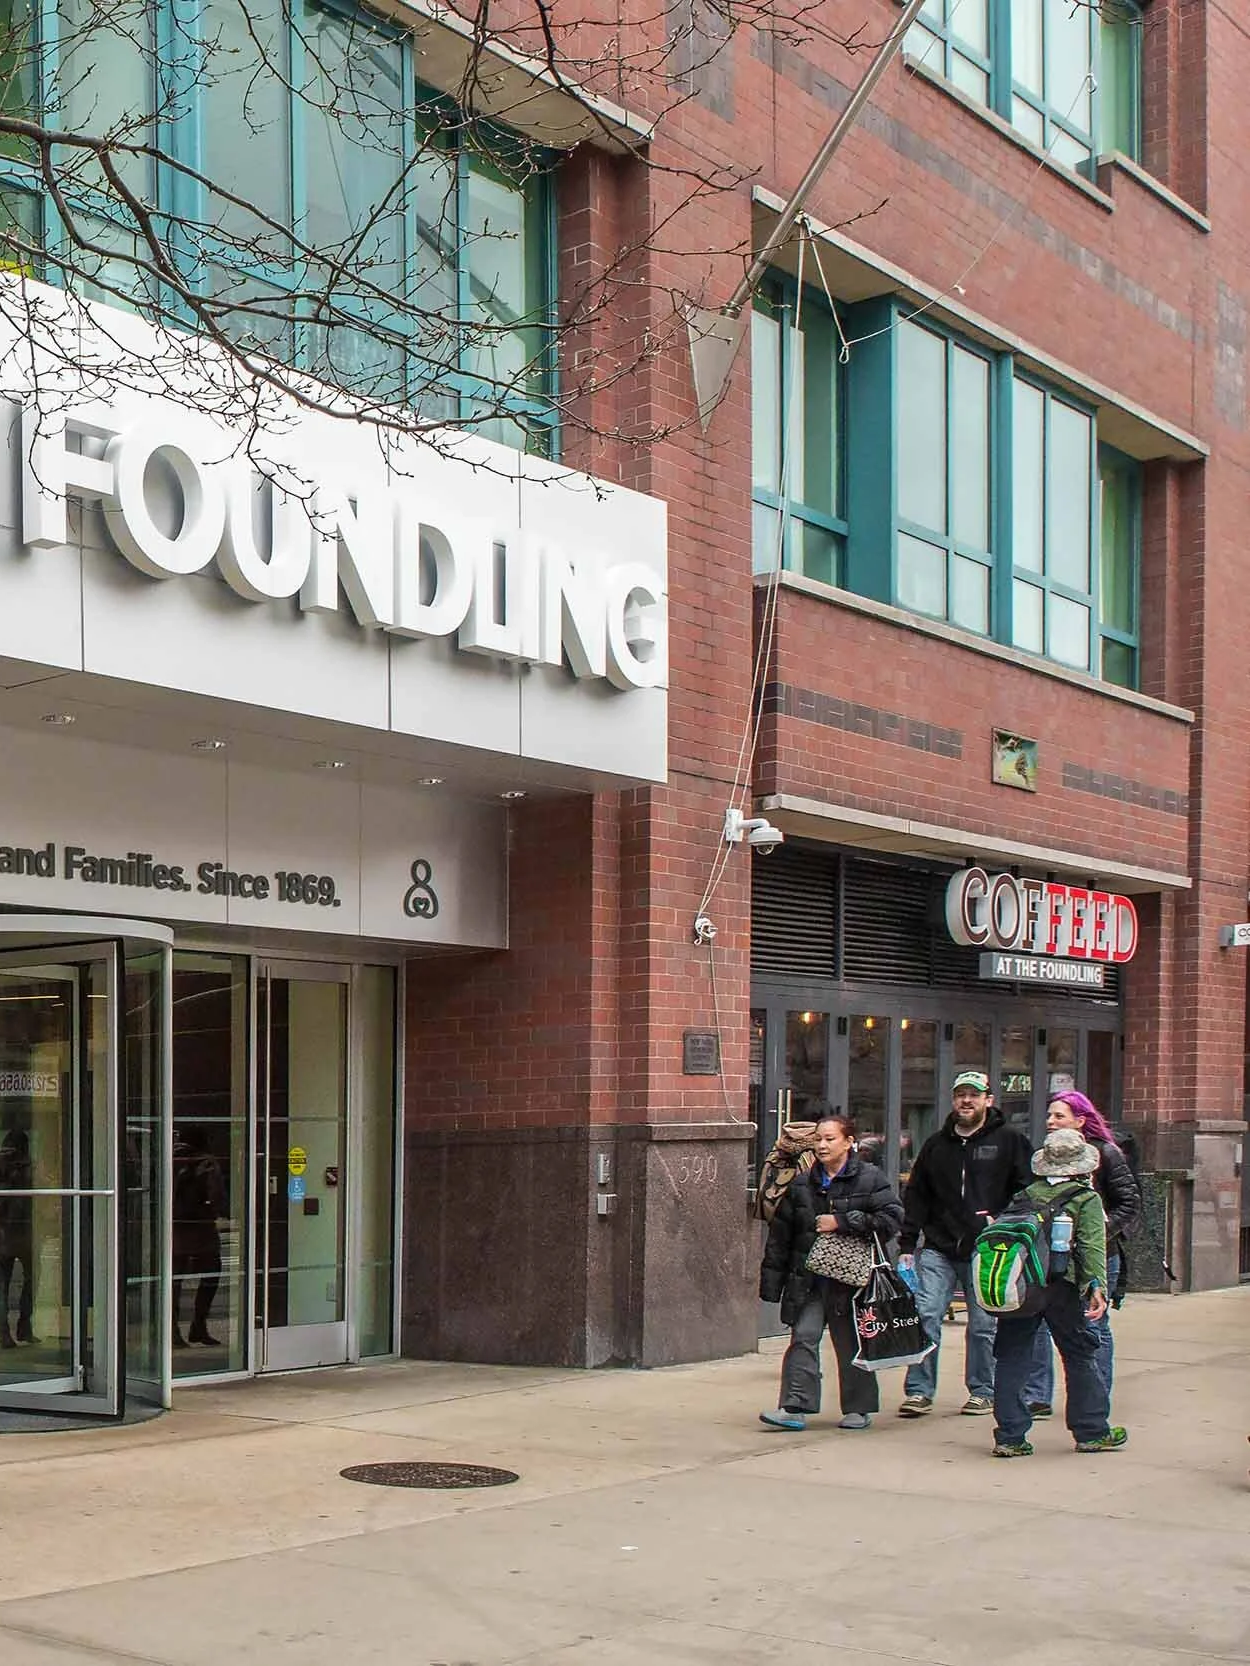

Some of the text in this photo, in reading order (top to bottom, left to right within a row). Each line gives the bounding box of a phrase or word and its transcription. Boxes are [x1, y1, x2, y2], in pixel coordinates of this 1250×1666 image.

[21, 388, 666, 691] FOUNDLING
[63, 846, 191, 892] Families.
[197, 861, 269, 899] Since
[274, 870, 341, 907] 1869.
[947, 866, 1139, 963] COFFEED
[997, 961, 1102, 984] AT THE FOUNDLING
[678, 1155, 718, 1184] 590
[864, 1320, 888, 1332] City
